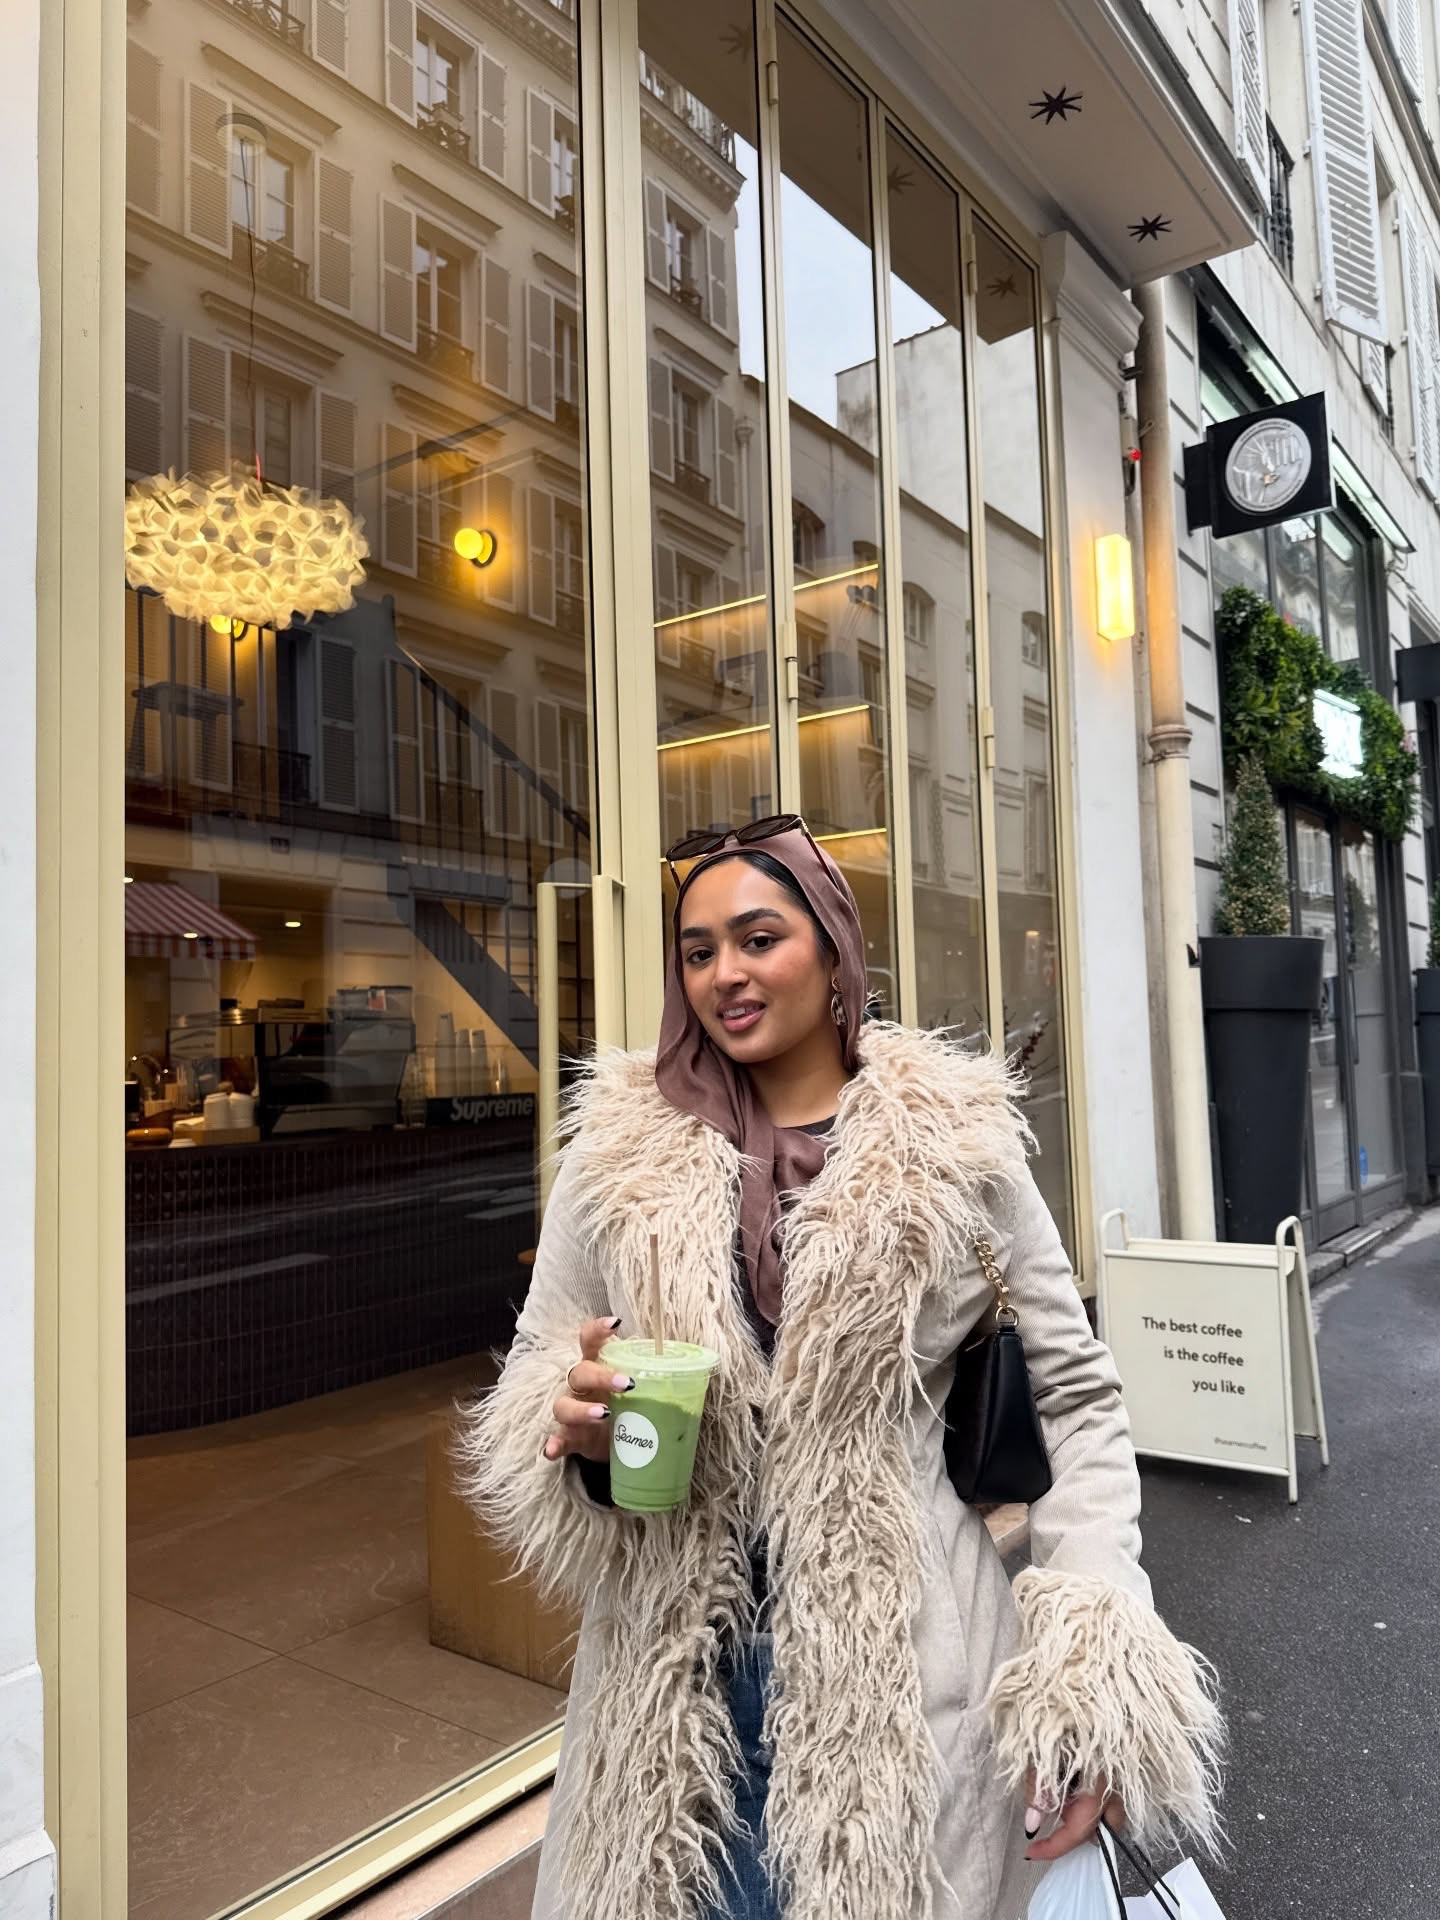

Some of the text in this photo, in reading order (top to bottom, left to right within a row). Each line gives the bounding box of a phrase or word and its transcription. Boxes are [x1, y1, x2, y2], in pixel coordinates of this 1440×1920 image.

[450, 1096, 533, 1124] Supreme
[1141, 1316, 1243, 1338] The best coffee
[1163, 1345, 1244, 1367] is the coffee
[1192, 1379, 1245, 1395] you like
